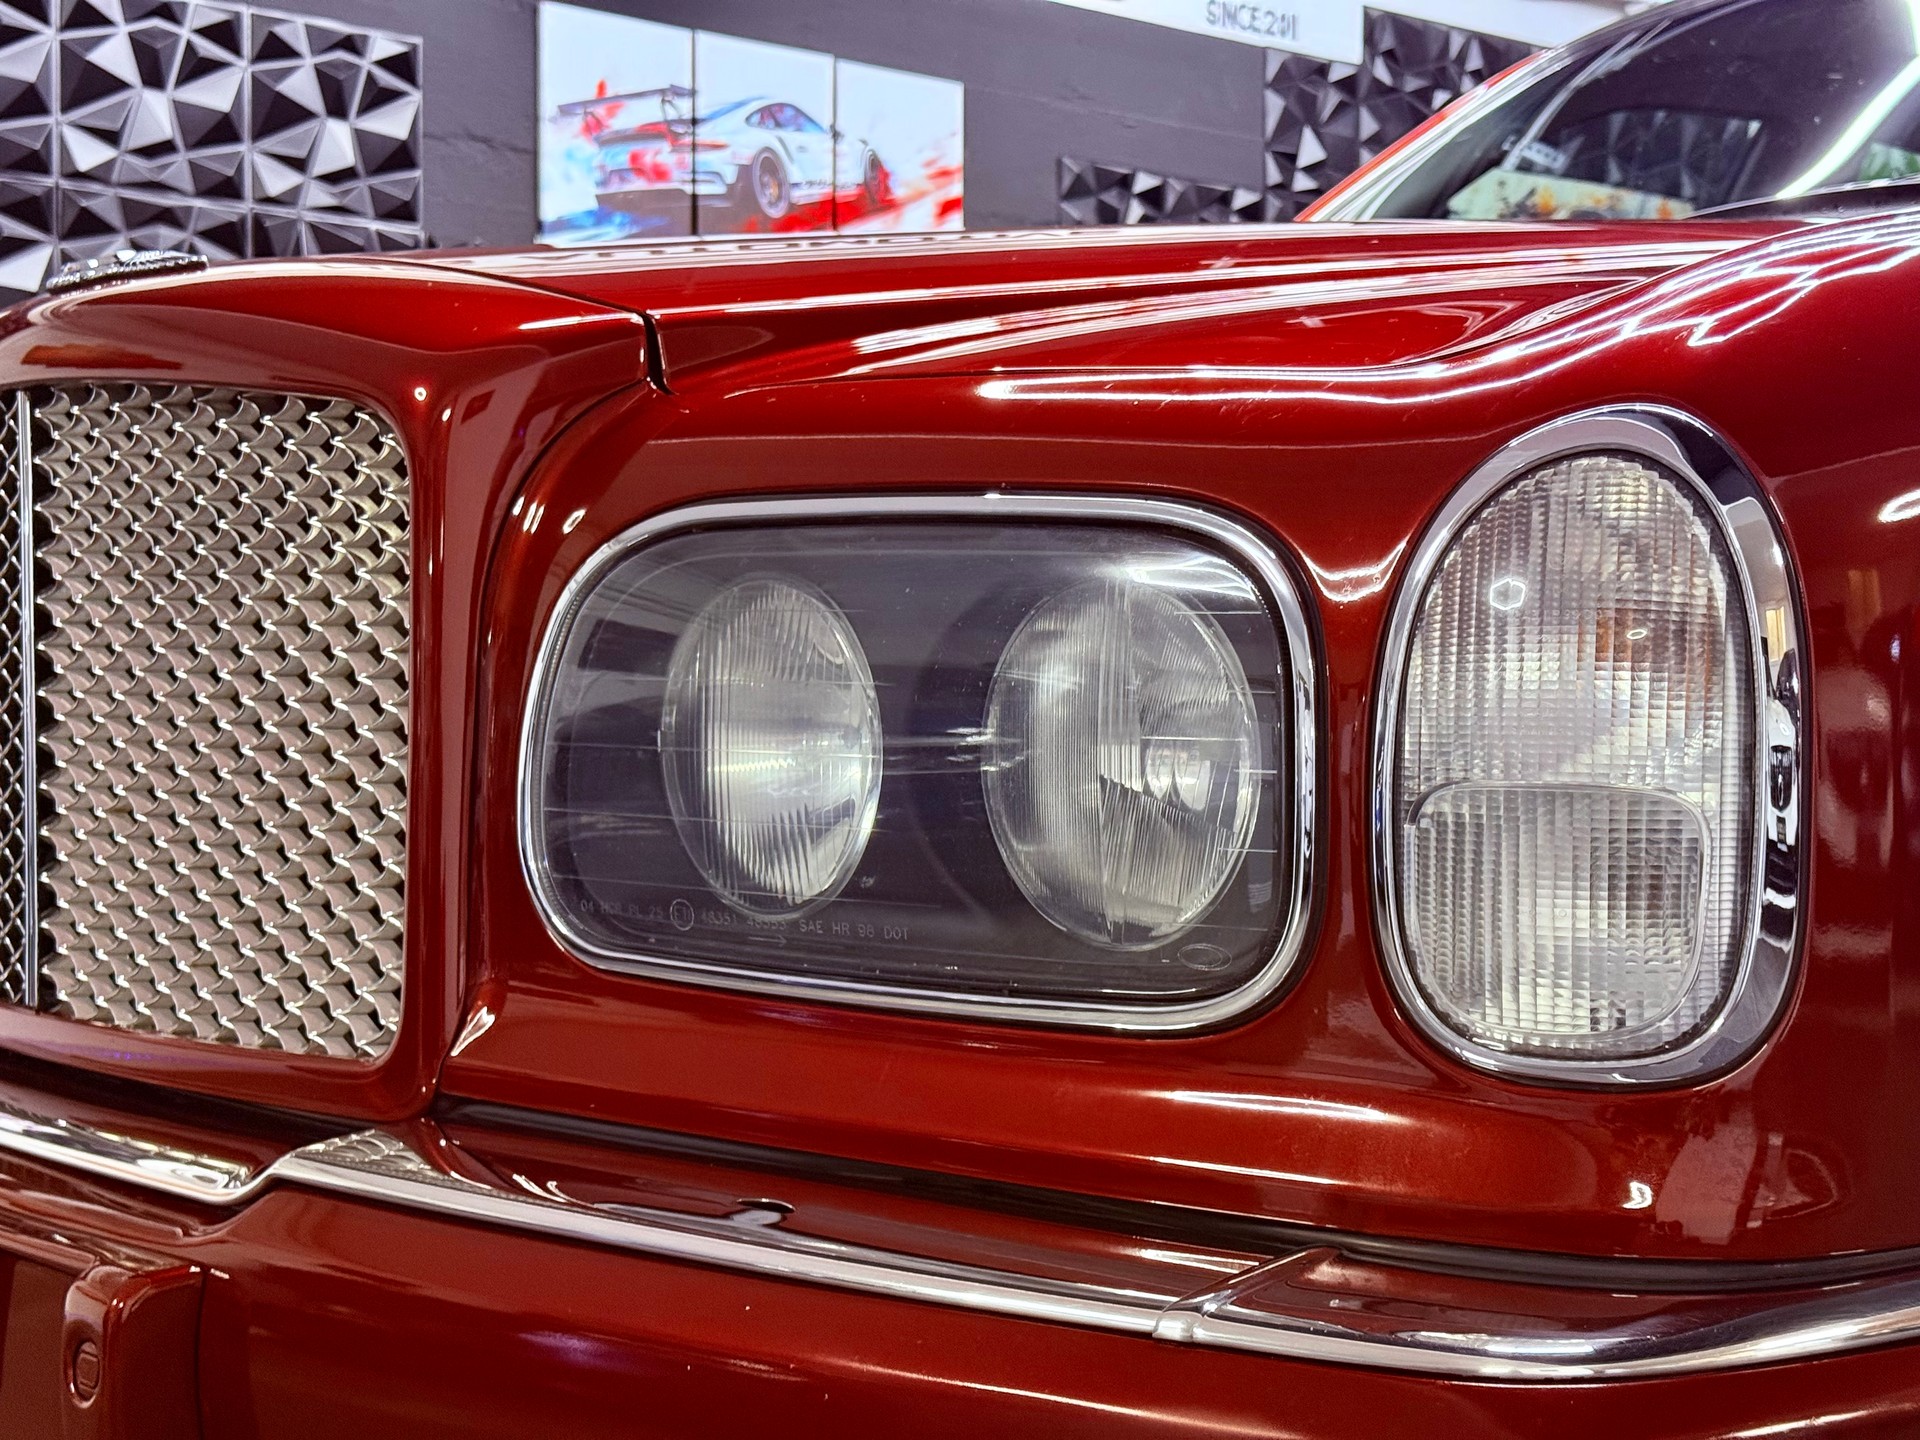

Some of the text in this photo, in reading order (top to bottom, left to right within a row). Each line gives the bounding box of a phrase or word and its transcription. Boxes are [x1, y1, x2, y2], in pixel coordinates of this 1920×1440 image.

[800, 919, 823, 934] SAE
[832, 921, 850, 936] HR
[883, 926, 909, 941] DOT
